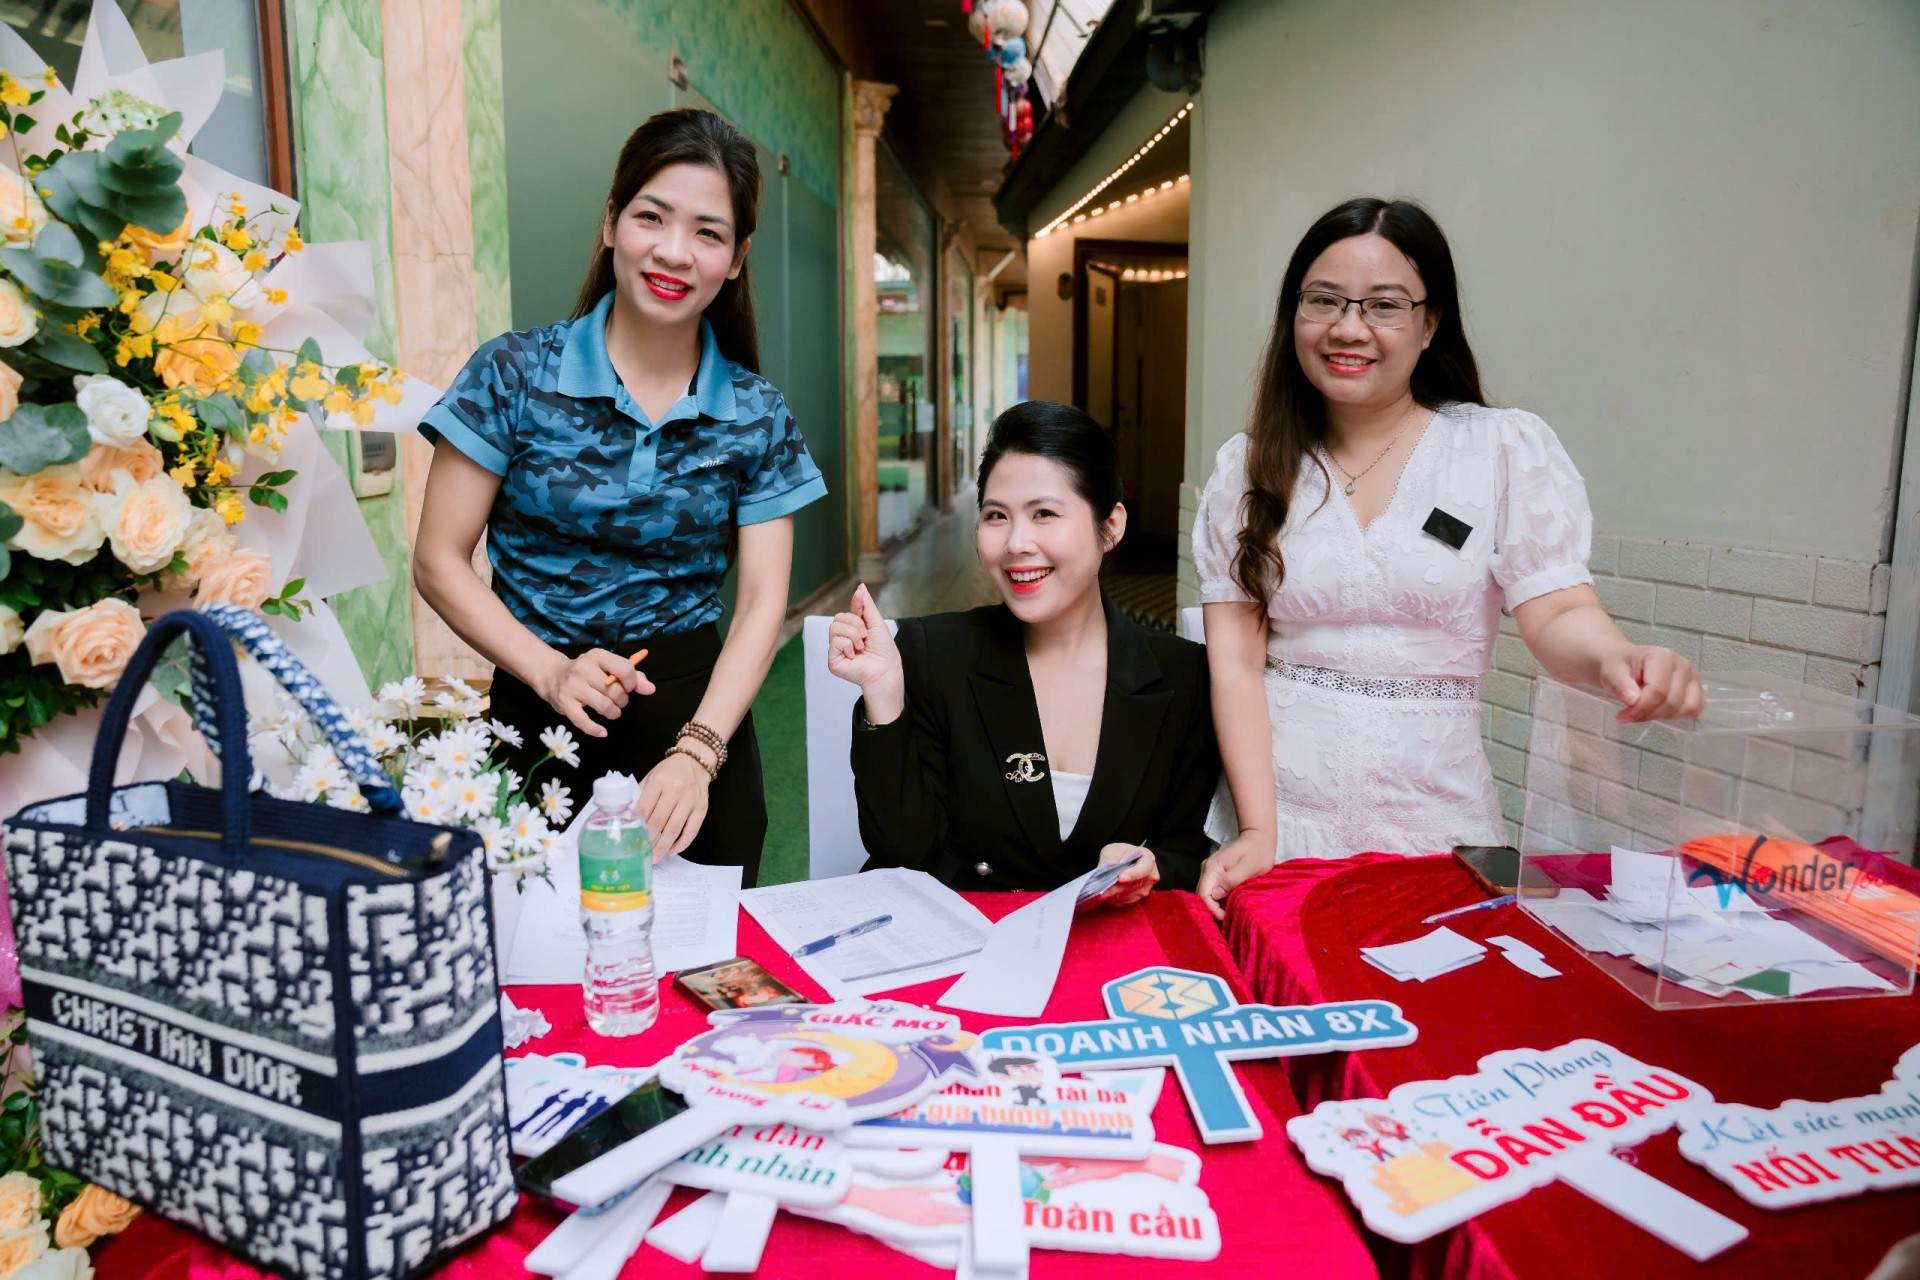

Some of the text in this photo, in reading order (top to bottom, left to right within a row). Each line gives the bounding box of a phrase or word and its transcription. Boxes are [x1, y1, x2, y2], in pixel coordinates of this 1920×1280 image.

[1688, 834, 1854, 909] Wonder
[52, 991, 303, 1106] CHRISTIAN DIOR
[1000, 1008, 1391, 1056] DOANH NHÂN 8X
[1413, 1049, 1614, 1119] Tiên Phong
[1569, 1073, 1692, 1130] ĐẦU
[737, 1152, 837, 1187] nhân
[1023, 1200, 1204, 1241] Toàn cầu
